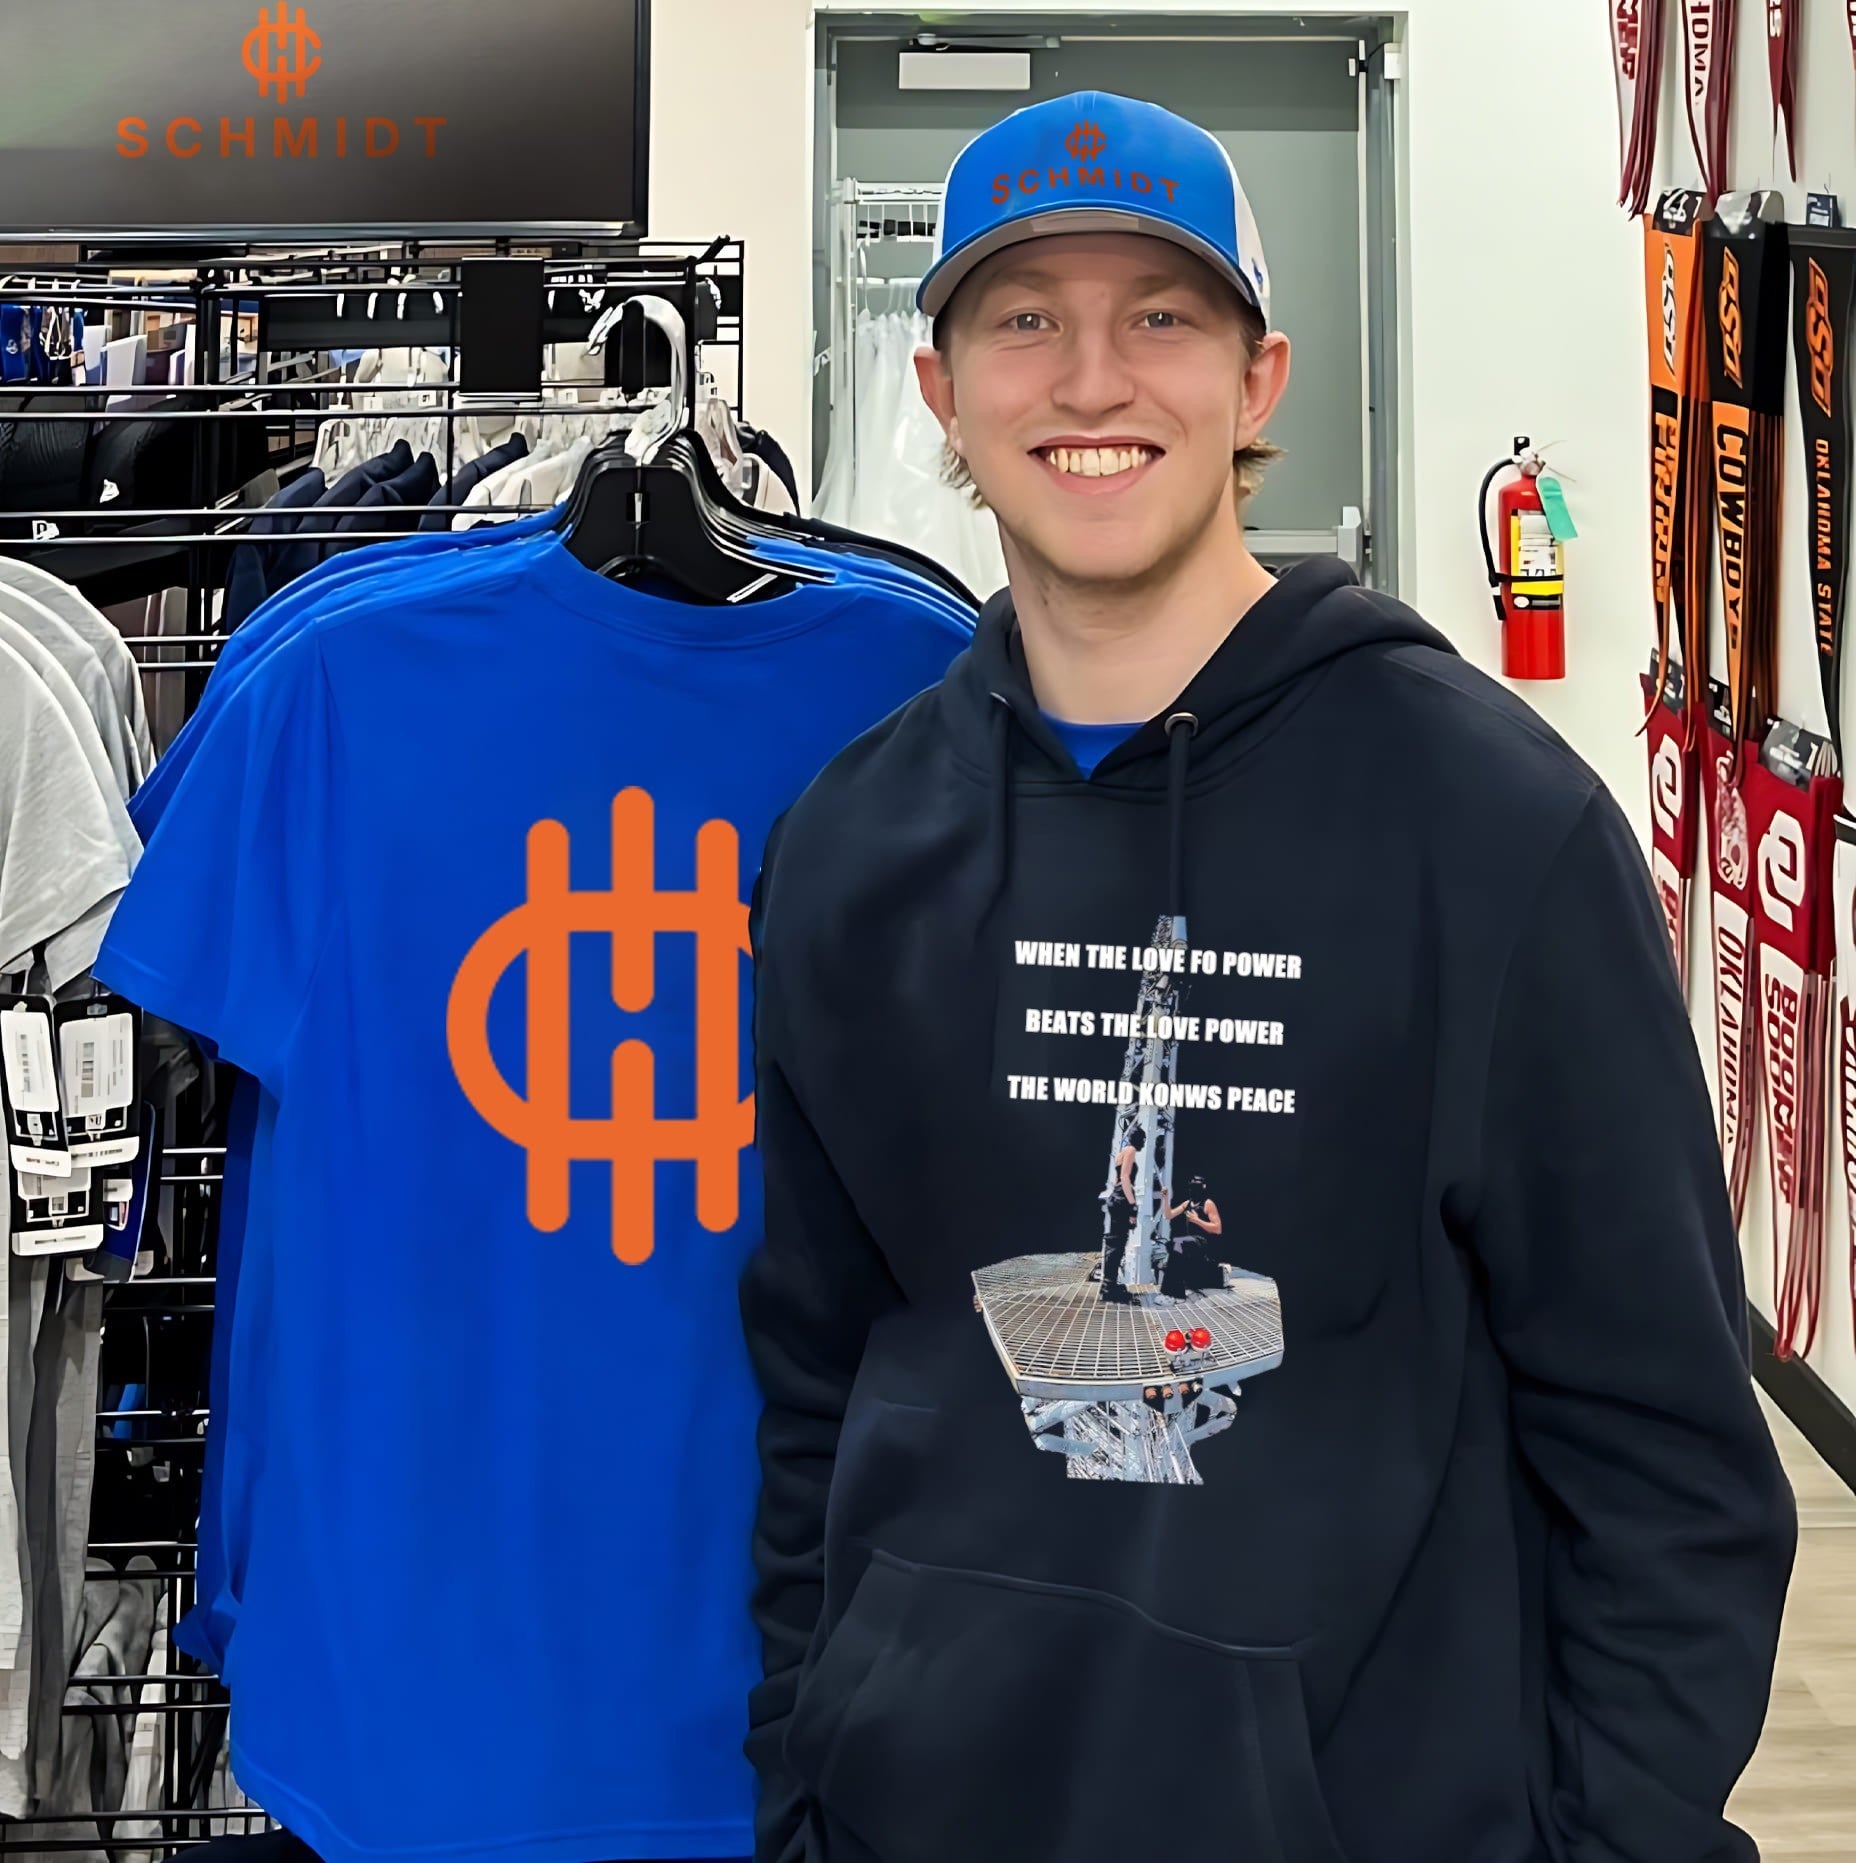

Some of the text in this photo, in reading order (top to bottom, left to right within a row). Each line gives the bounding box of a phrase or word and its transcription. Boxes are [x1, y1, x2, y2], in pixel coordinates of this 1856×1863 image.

[116, 116, 447, 159] SCHMIDT
[991, 166, 1180, 205] SCHMIDT
[1814, 438, 1832, 570] OKLAHOMA
[1014, 940, 1302, 979] WHEN THE LOVE FO POWER
[1025, 1008, 1285, 1045] BEATS THE LOVE POWER
[1717, 925, 1746, 1145] OKLAHOMA
[1007, 1075, 1296, 1113] THE WORLD KONWS PEACE
